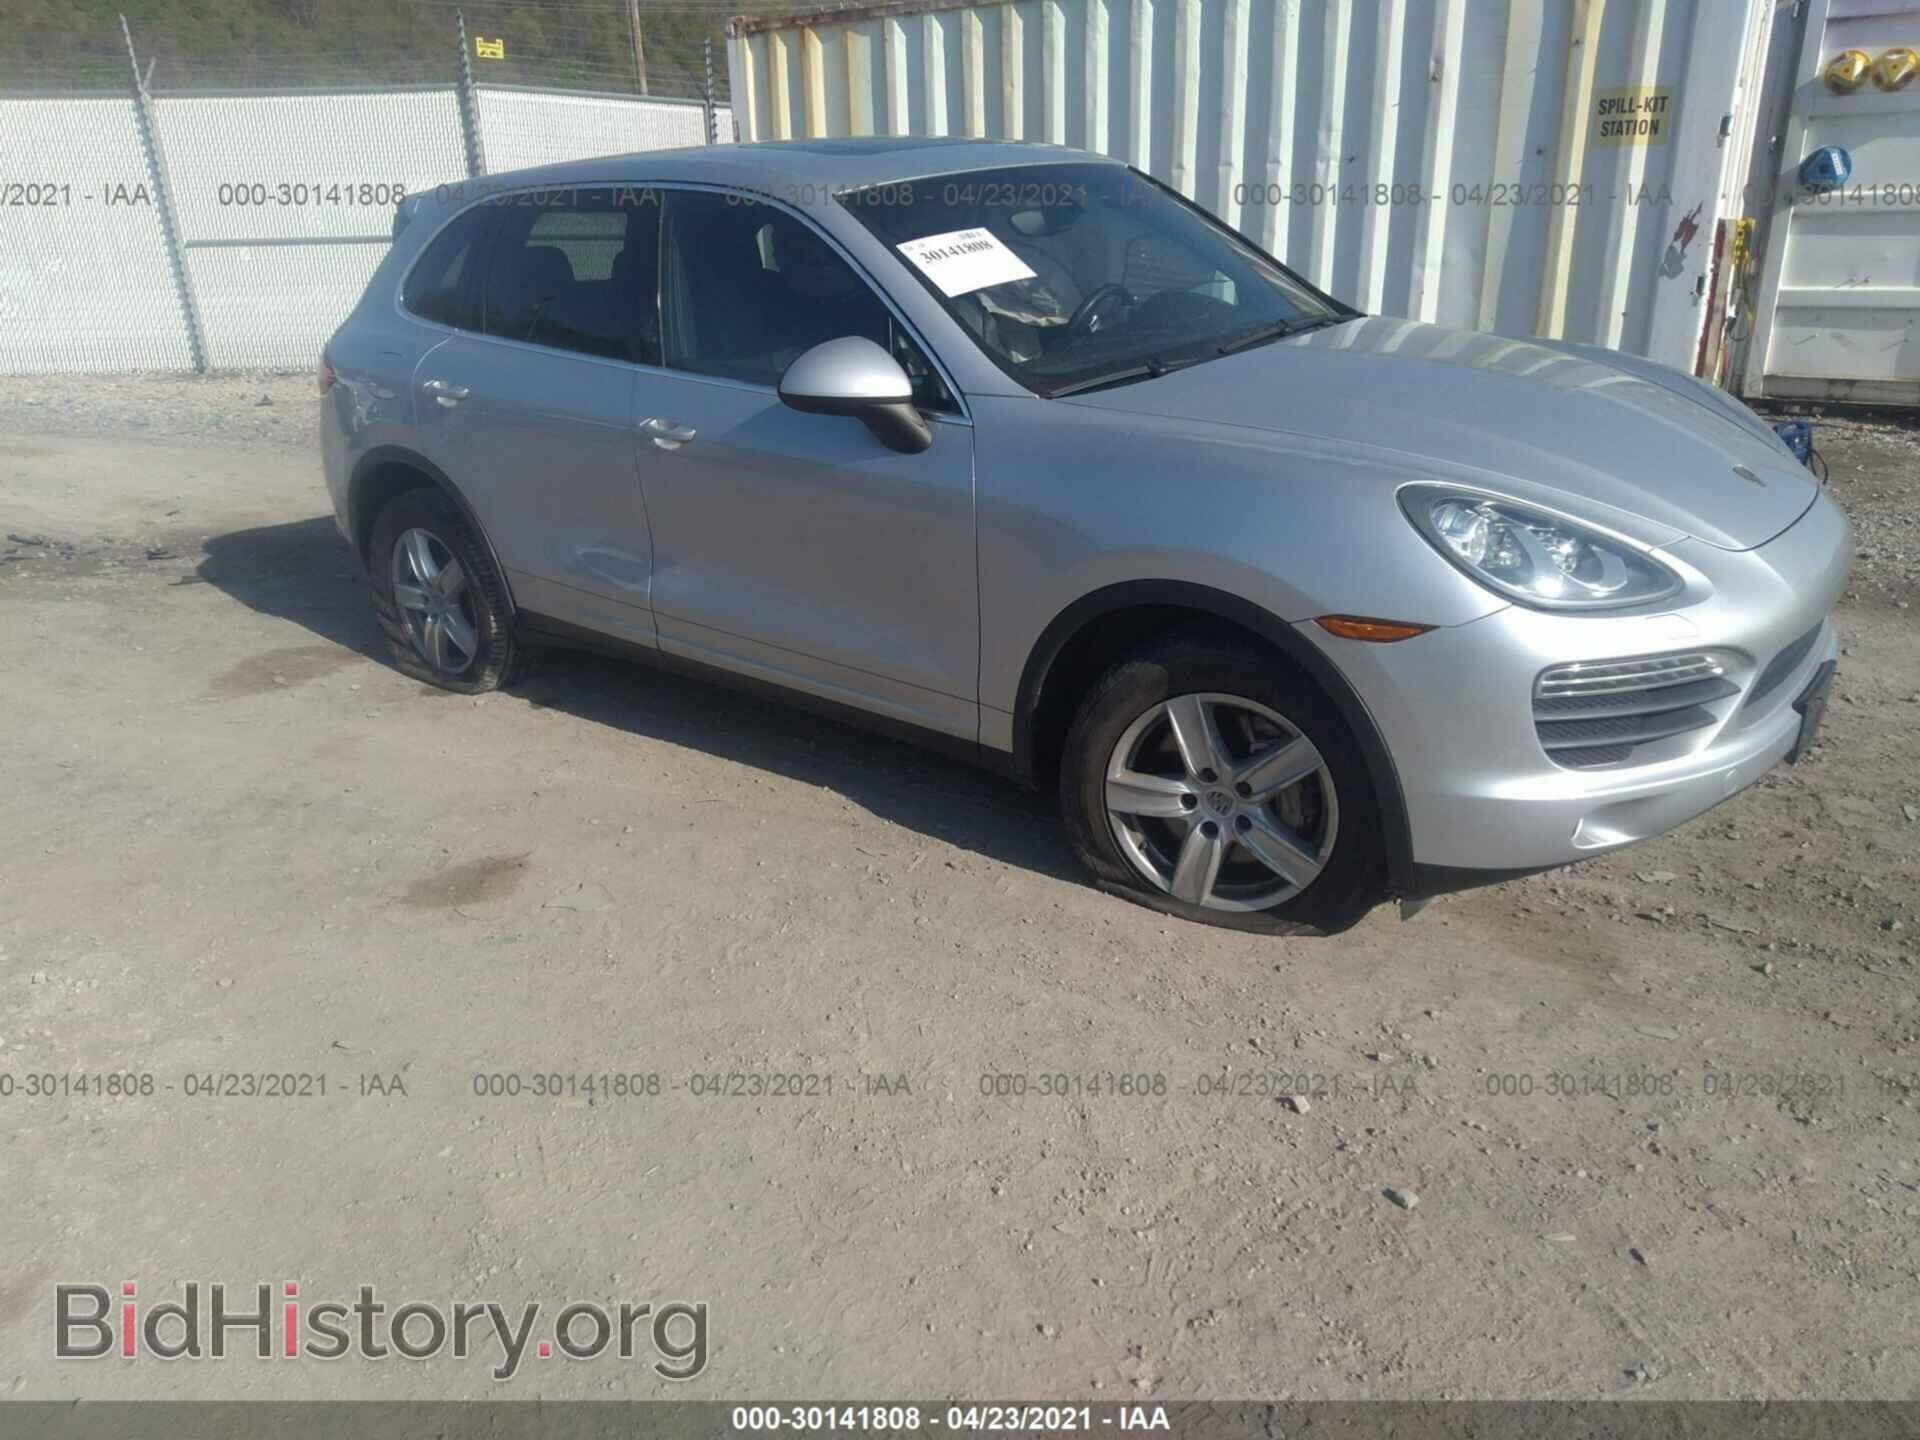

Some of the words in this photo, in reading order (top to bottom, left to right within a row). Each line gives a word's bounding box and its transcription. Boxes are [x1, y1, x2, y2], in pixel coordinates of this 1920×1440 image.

[1598, 96, 1669, 116] SPILL-KIT
[1600, 119, 1661, 137] STATION
[920, 240, 993, 264] 30141808
